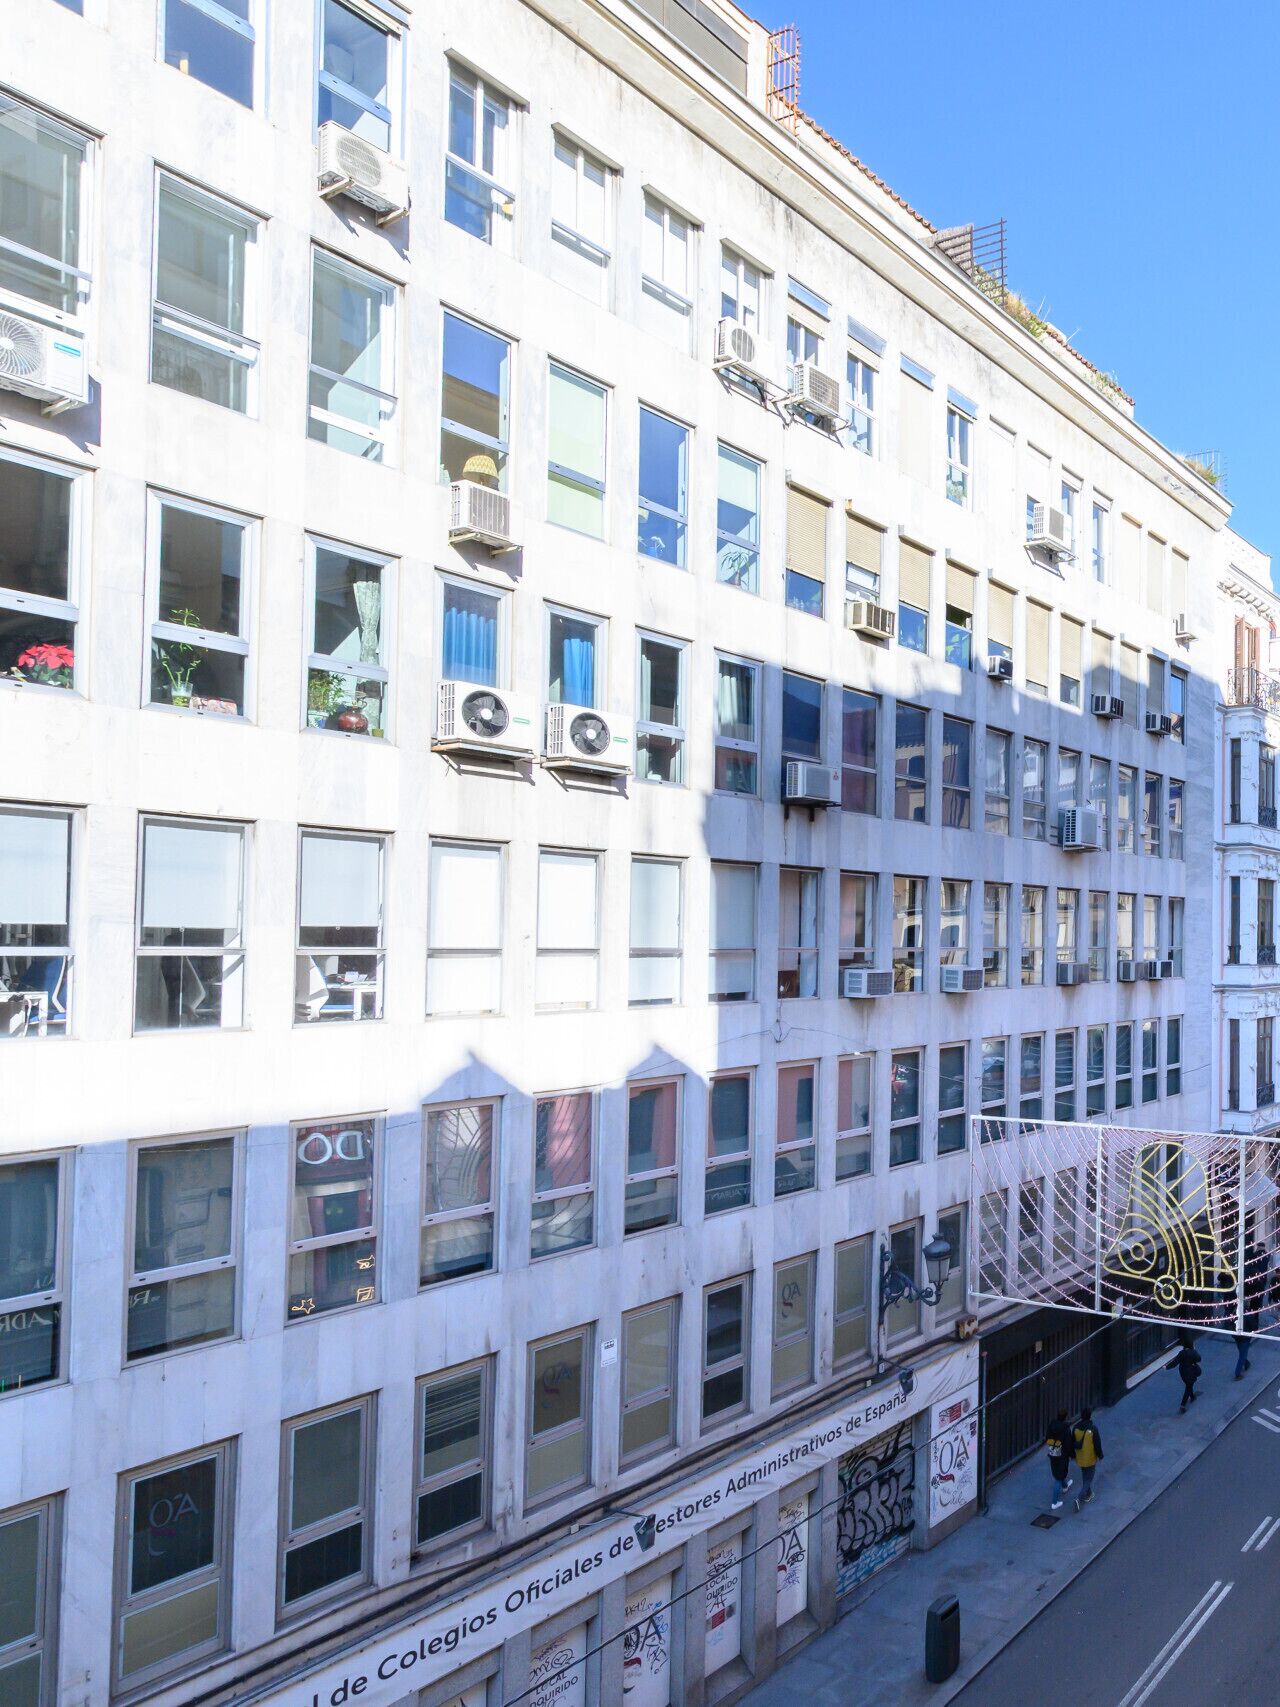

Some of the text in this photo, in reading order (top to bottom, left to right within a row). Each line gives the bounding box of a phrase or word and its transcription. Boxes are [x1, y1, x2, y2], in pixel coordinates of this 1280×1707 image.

[330, 1678, 368, 1707] de
[377, 1606, 498, 1680] Colegios
[504, 1551, 604, 1613] Oficiales
[608, 1535, 634, 1559] de
[655, 1488, 721, 1534] estores
[725, 1426, 842, 1497] Administrativos
[845, 1415, 862, 1433] de
[865, 1392, 907, 1423] España
